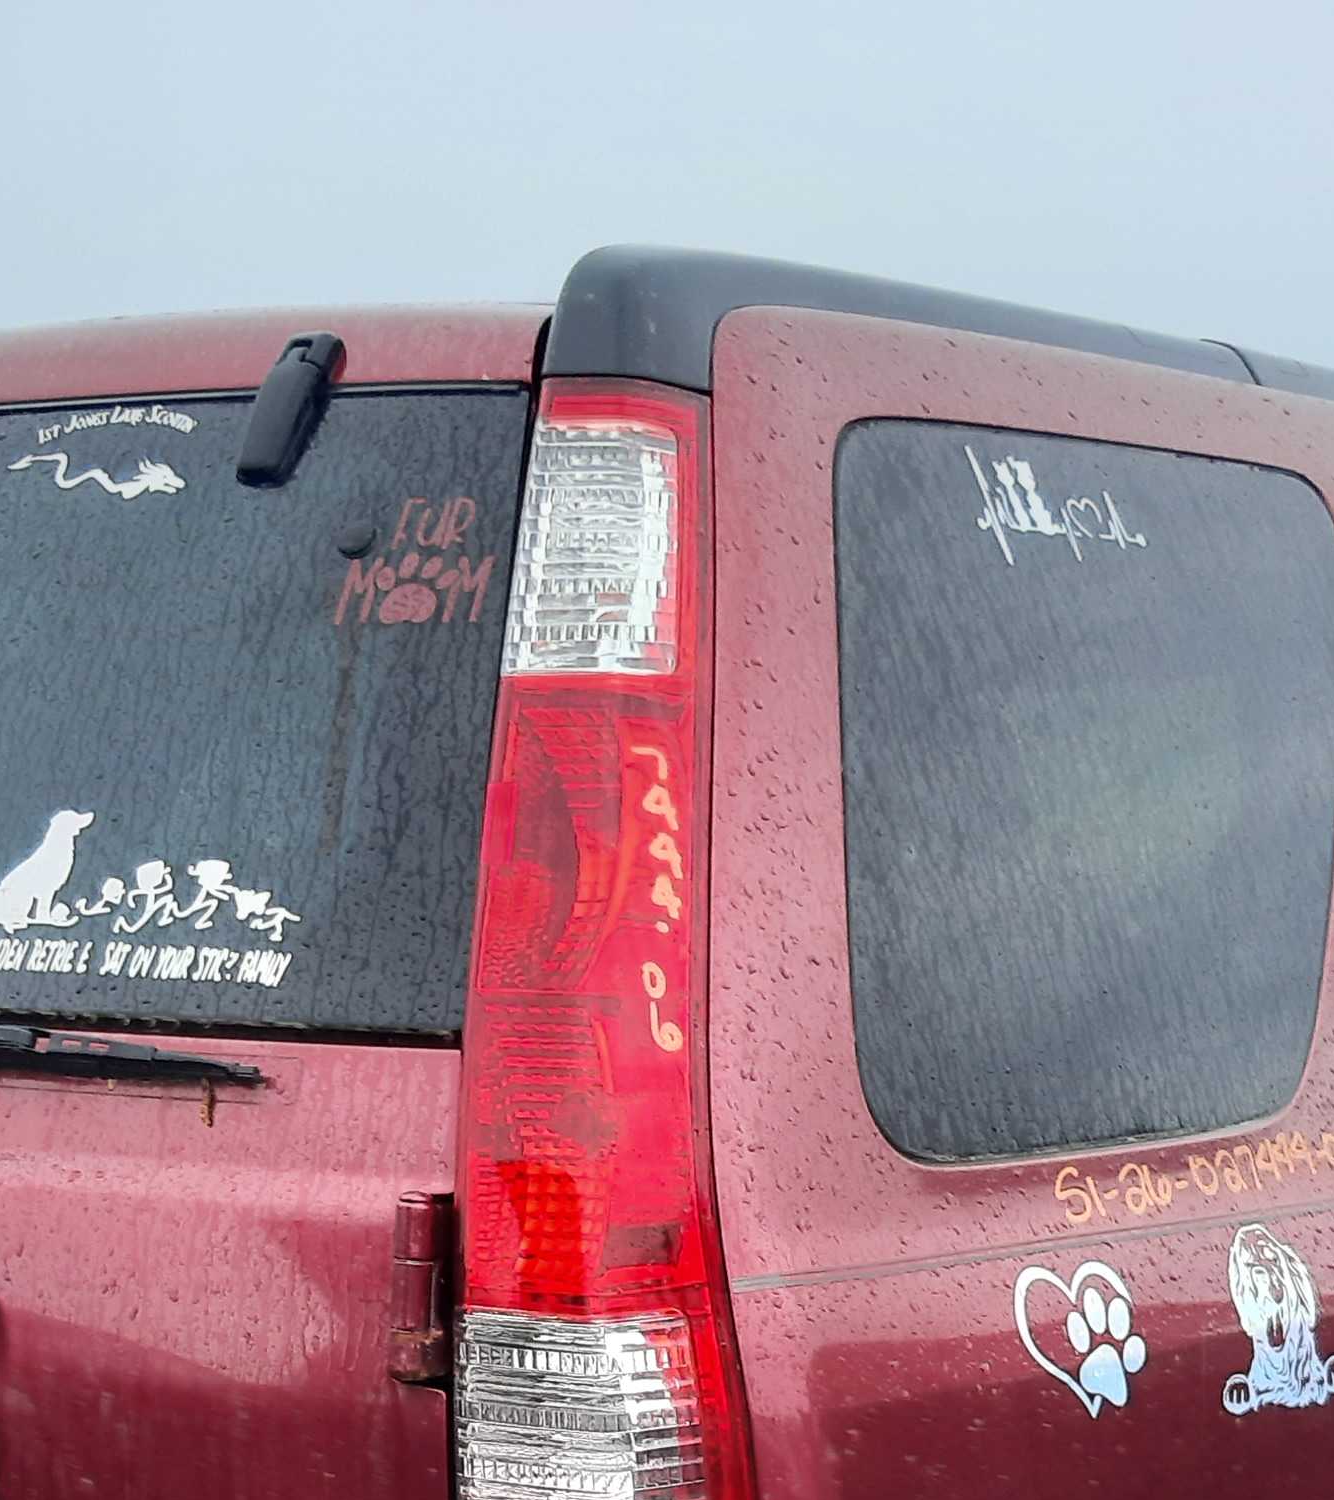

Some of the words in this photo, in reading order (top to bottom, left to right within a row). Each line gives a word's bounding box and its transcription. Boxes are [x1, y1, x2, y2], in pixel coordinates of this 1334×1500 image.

[391, 496, 476, 550] FUR
[99, 941, 132, 976] SAT
[153, 945, 196, 980] YOUR
[236, 950, 292, 987] FAMILY
